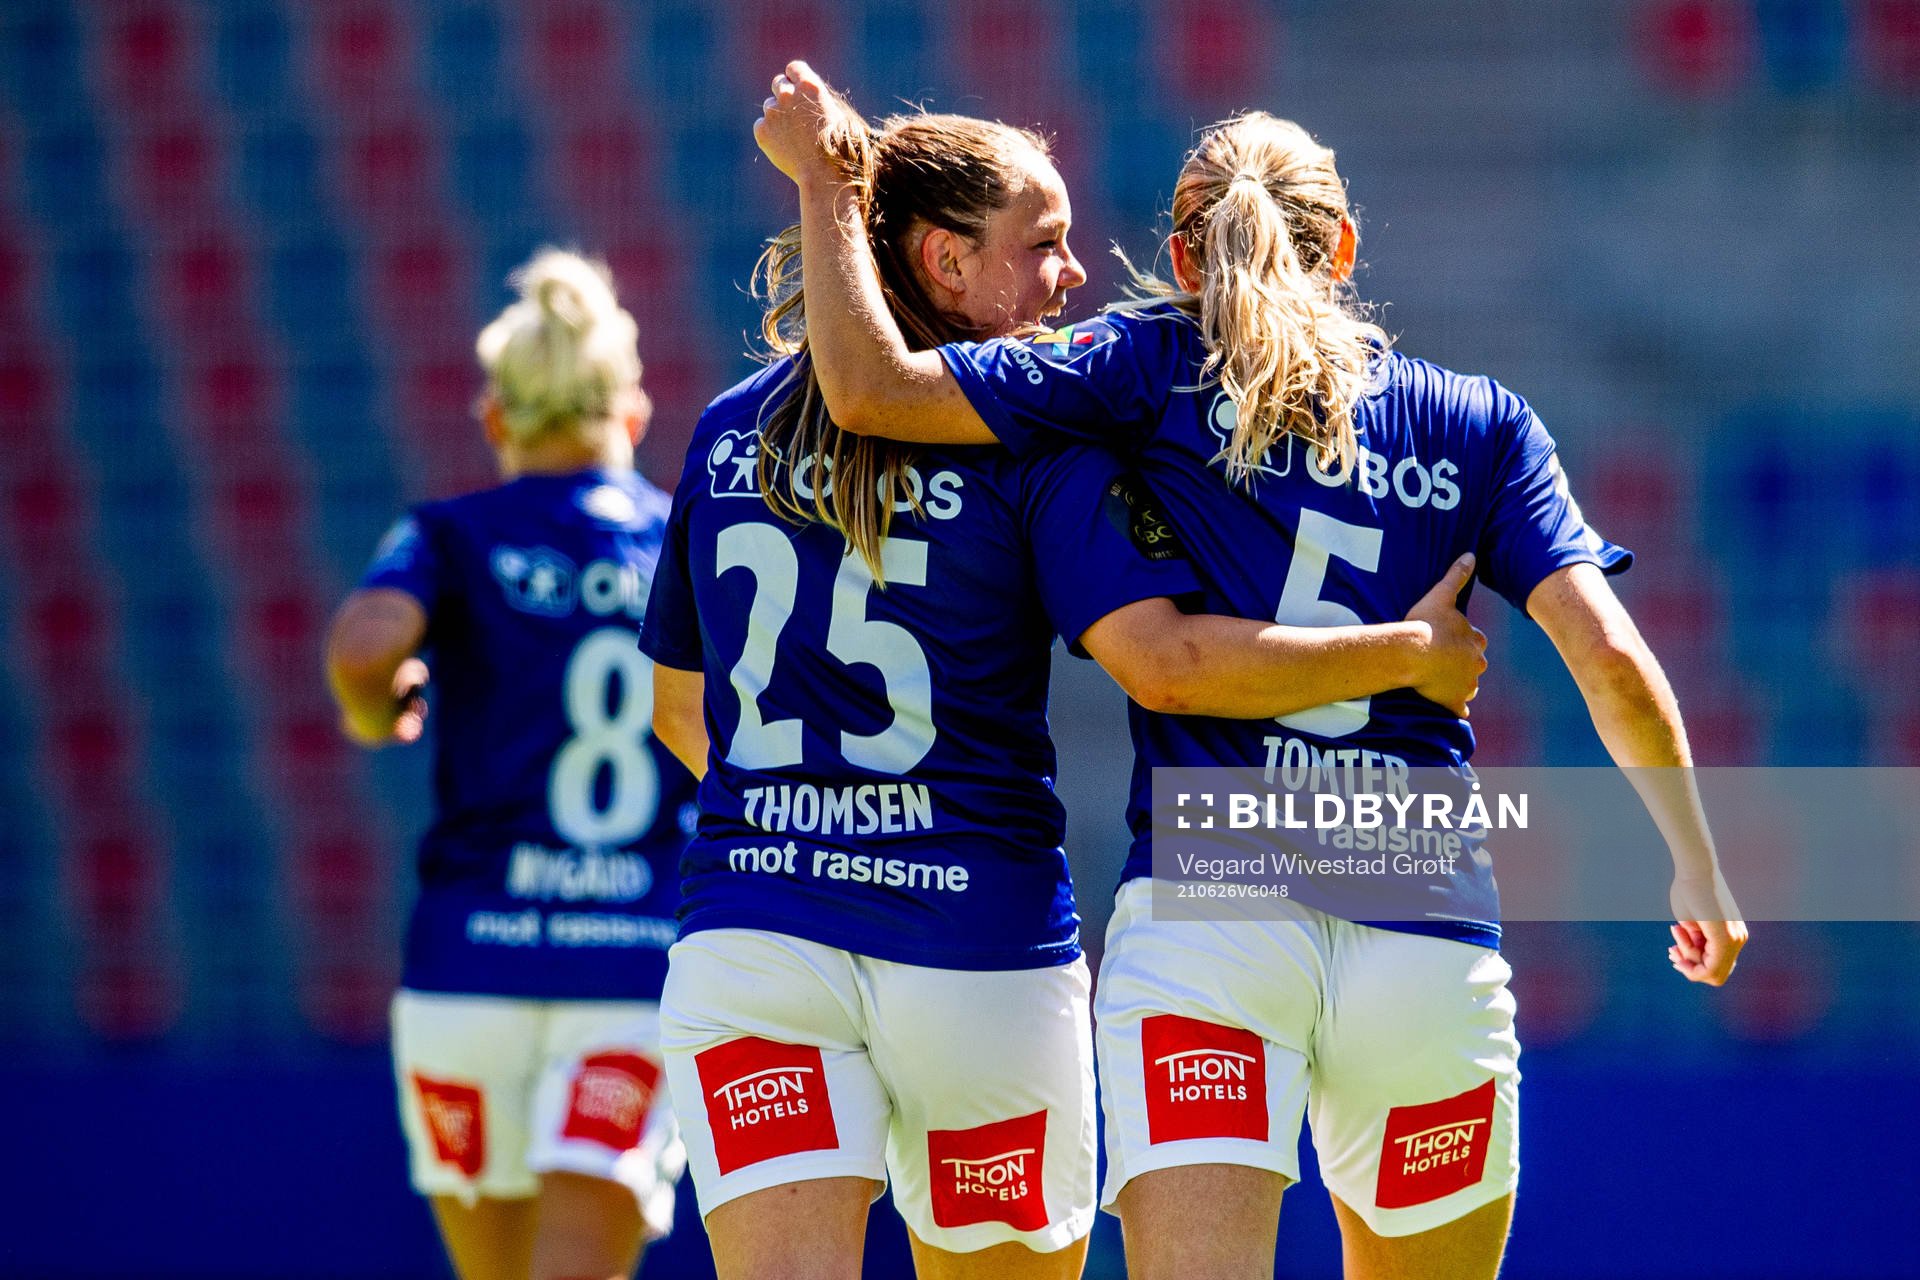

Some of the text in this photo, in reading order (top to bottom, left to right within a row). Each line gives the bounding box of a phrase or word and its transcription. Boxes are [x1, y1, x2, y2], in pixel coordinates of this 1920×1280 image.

[793, 451, 964, 520] OOS
[1305, 437, 1461, 511] OBOS
[1274, 507, 1383, 738] 5
[716, 522, 937, 775] 25
[549, 626, 660, 847] 8
[1263, 736, 1410, 803] TOMTER
[743, 783, 933, 835] THOMSEN
[729, 841, 969, 892] mot rasisme
[713, 1066, 814, 1111] THON
[1155, 1048, 1257, 1082] THON
[730, 1098, 809, 1131] HOTELS
[1170, 1084, 1248, 1103] HOTELS
[1394, 1117, 1487, 1158] THON
[1403, 1145, 1470, 1175] HOTELS
[941, 1148, 1035, 1185] THON
[956, 1180, 1028, 1201] HOTELS
